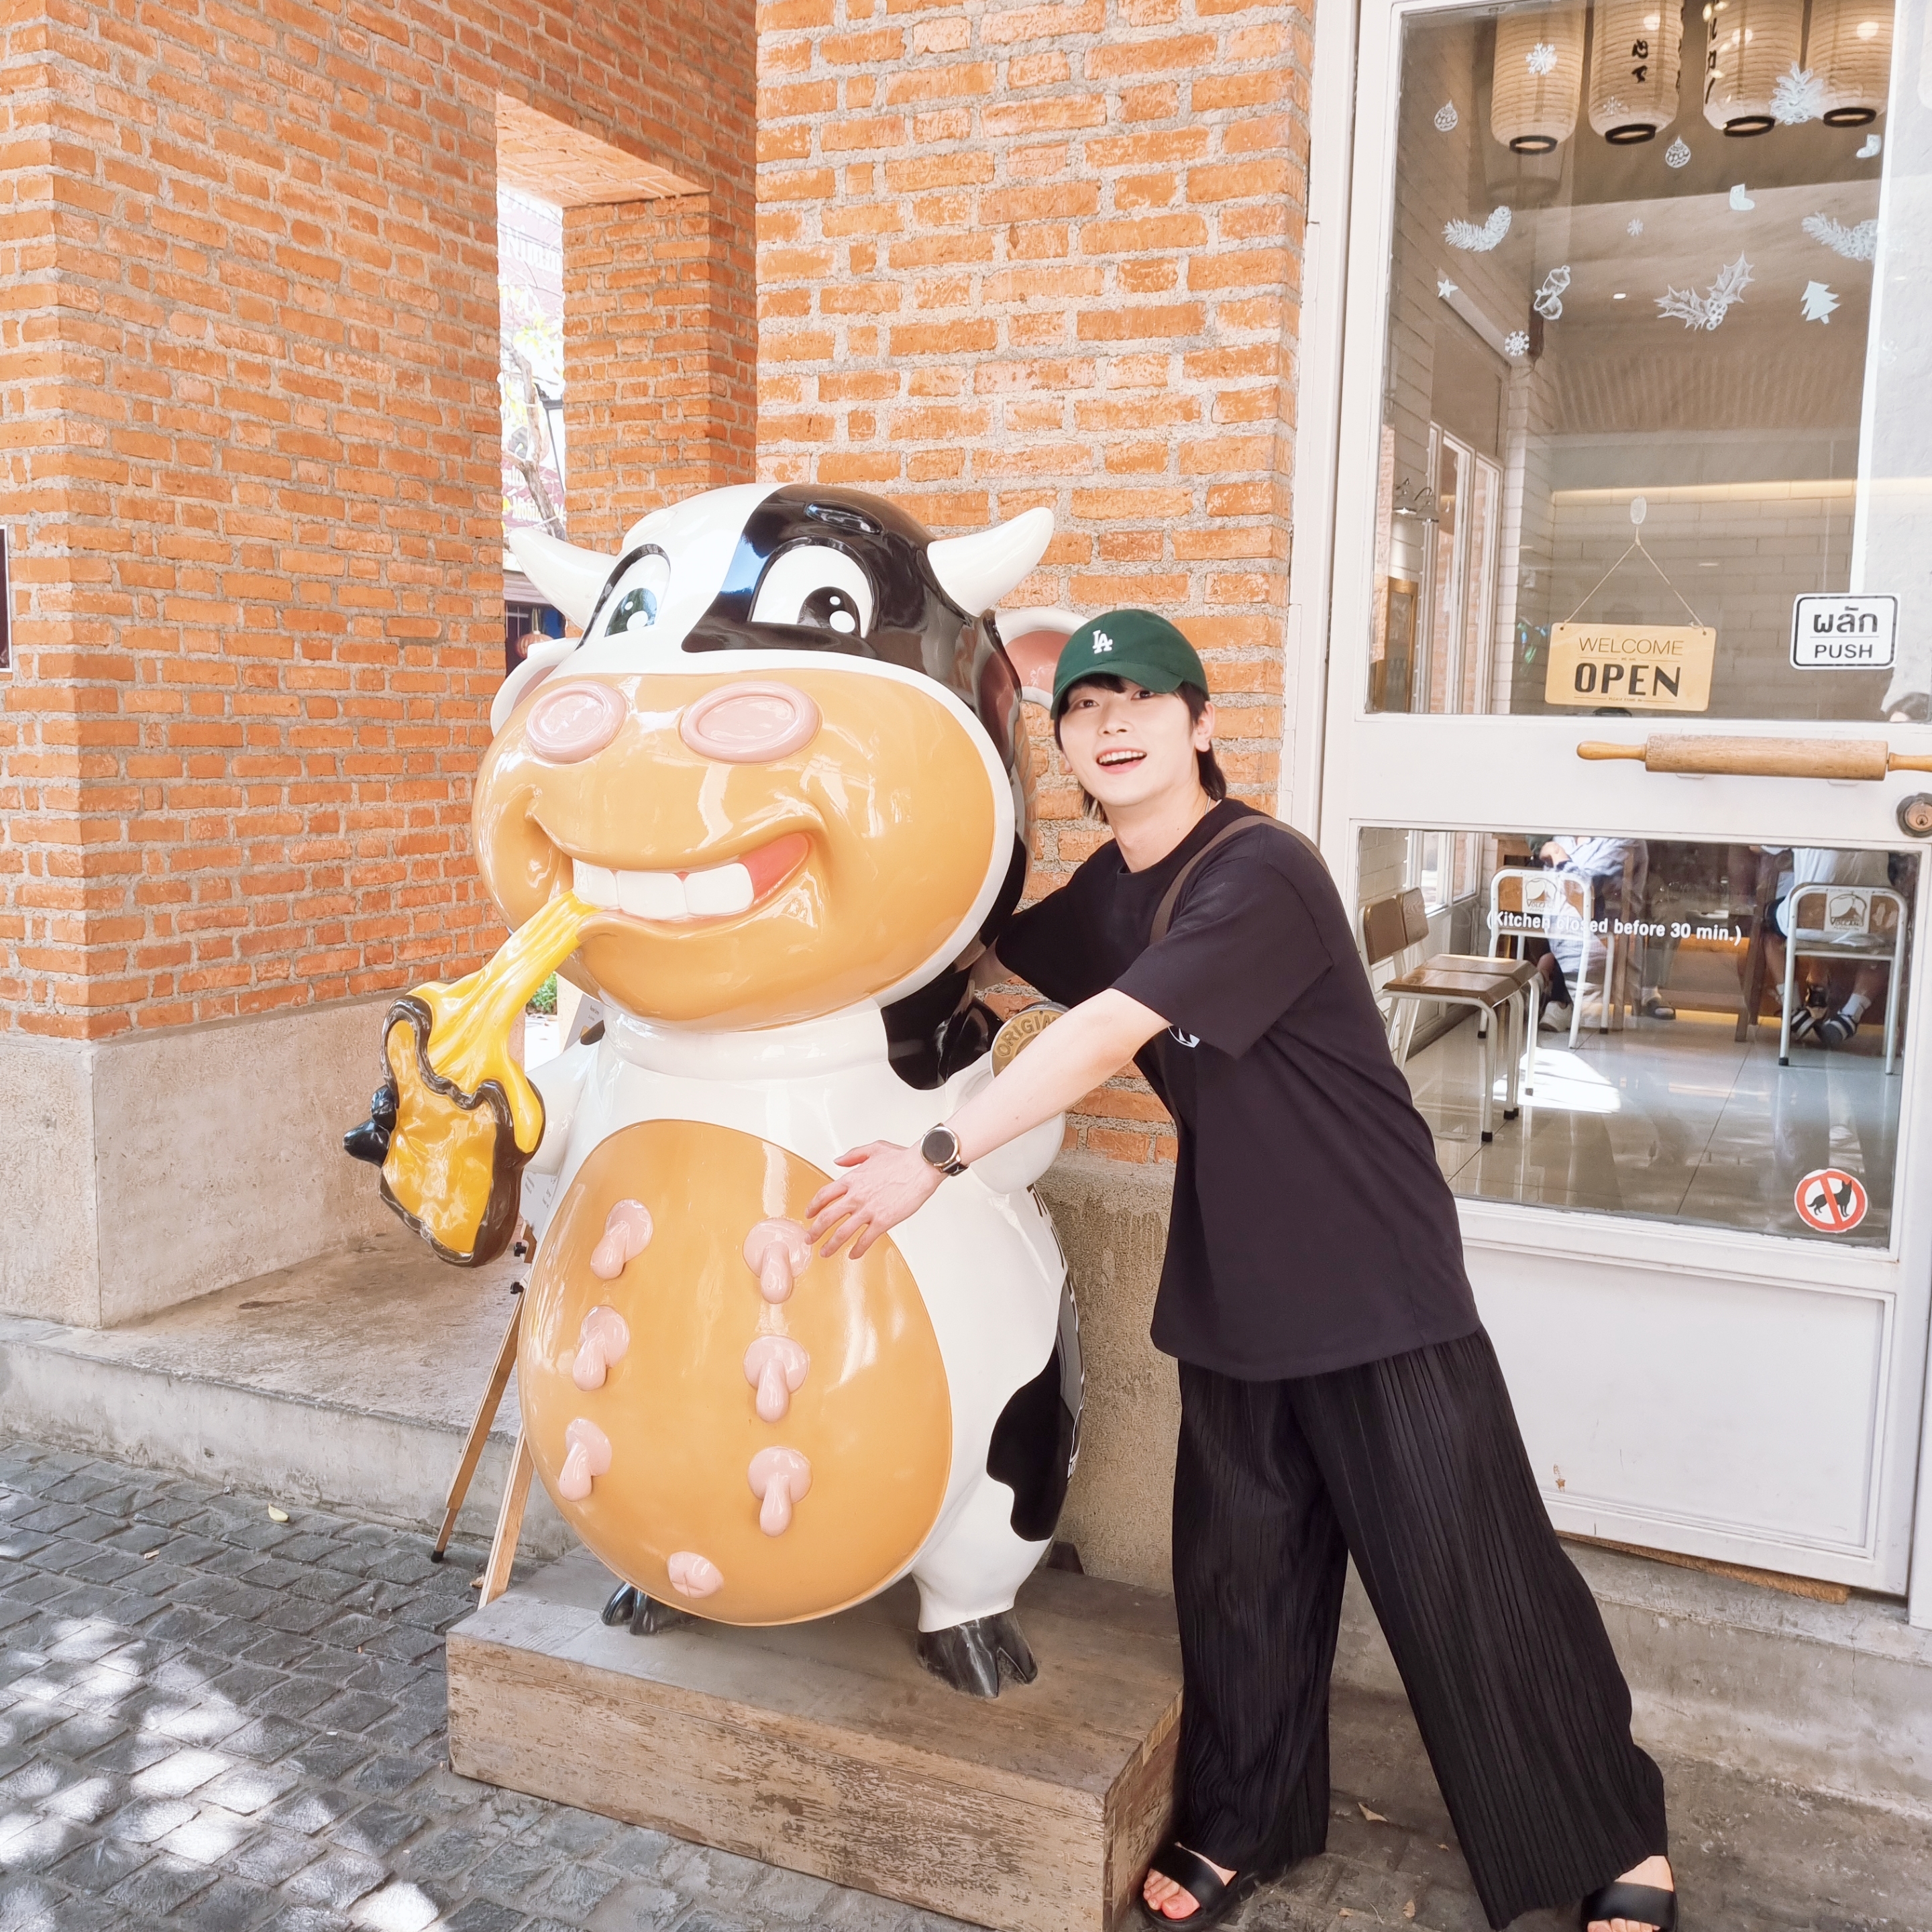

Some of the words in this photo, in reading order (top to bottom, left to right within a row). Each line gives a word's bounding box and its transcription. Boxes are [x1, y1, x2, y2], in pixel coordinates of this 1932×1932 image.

[1813, 606, 1878, 633] ผลัก
[1092, 629, 1113, 654] LA
[1579, 637, 1684, 656] WELCOME
[1814, 644, 1873, 659] PUSH
[1574, 663, 1681, 697] OPEN
[1487, 910, 1550, 930] (Kitchen
[1614, 918, 1665, 937] before
[1670, 922, 1690, 939] 30
[1696, 923, 1742, 946] min.)
[996, 1014, 1058, 1057] ORIGIN
